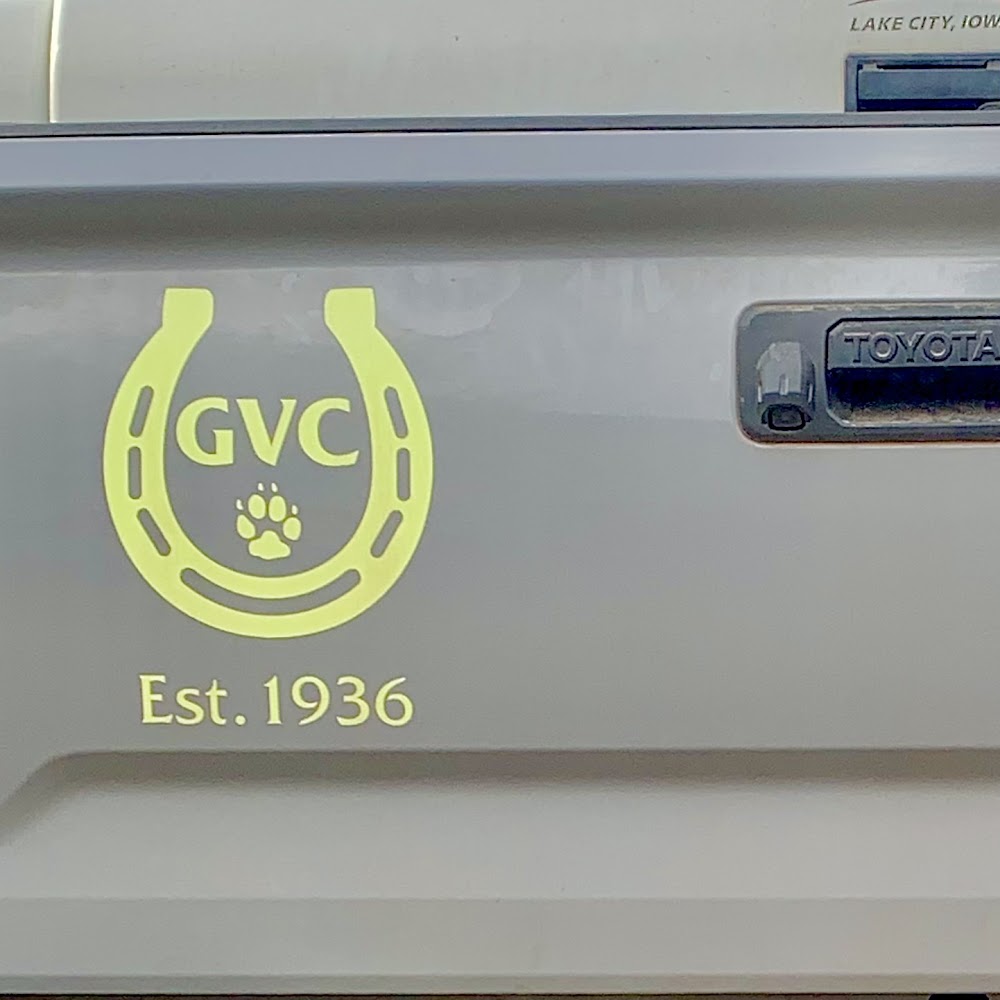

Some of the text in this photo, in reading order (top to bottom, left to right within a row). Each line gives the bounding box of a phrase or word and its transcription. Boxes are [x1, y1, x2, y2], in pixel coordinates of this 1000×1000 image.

[850, 16, 904, 32] LAKE
[908, 15, 955, 32] CITY,
[175, 397, 360, 467] GVC
[139, 673, 414, 727] Est. 1936
